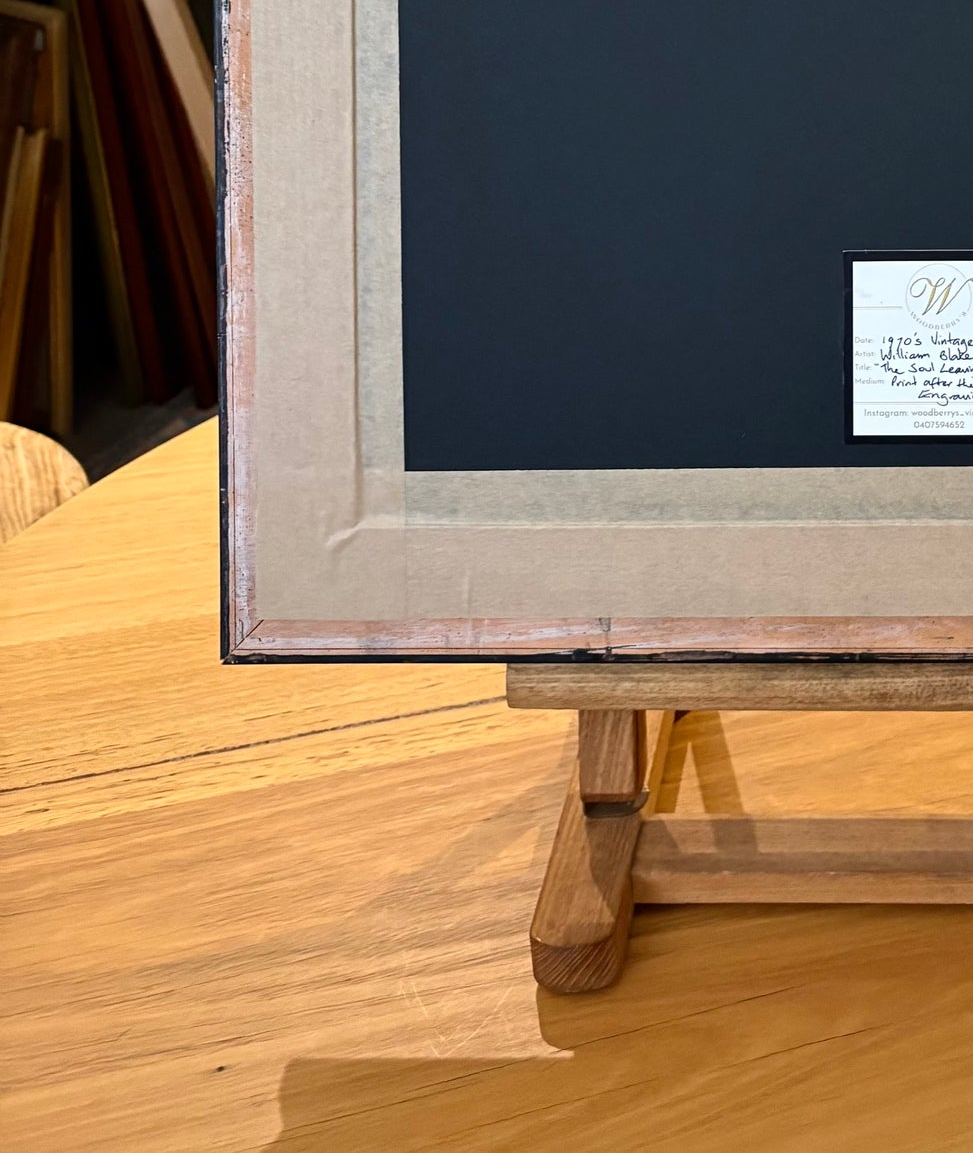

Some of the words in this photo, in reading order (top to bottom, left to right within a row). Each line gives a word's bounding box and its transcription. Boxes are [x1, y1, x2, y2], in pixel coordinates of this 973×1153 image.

[854, 336, 874, 344] Date:
[882, 332, 922, 352] 1970's
[854, 350, 876, 358] Artist:
[880, 348, 931, 361] William
[854, 363, 873, 371] Title:
[908, 362, 935, 373] Soul
[891, 375, 918, 387] Print
[923, 376, 953, 389] after
[863, 408, 909, 418] Instagram:
[913, 420, 965, 429] 0407594652
